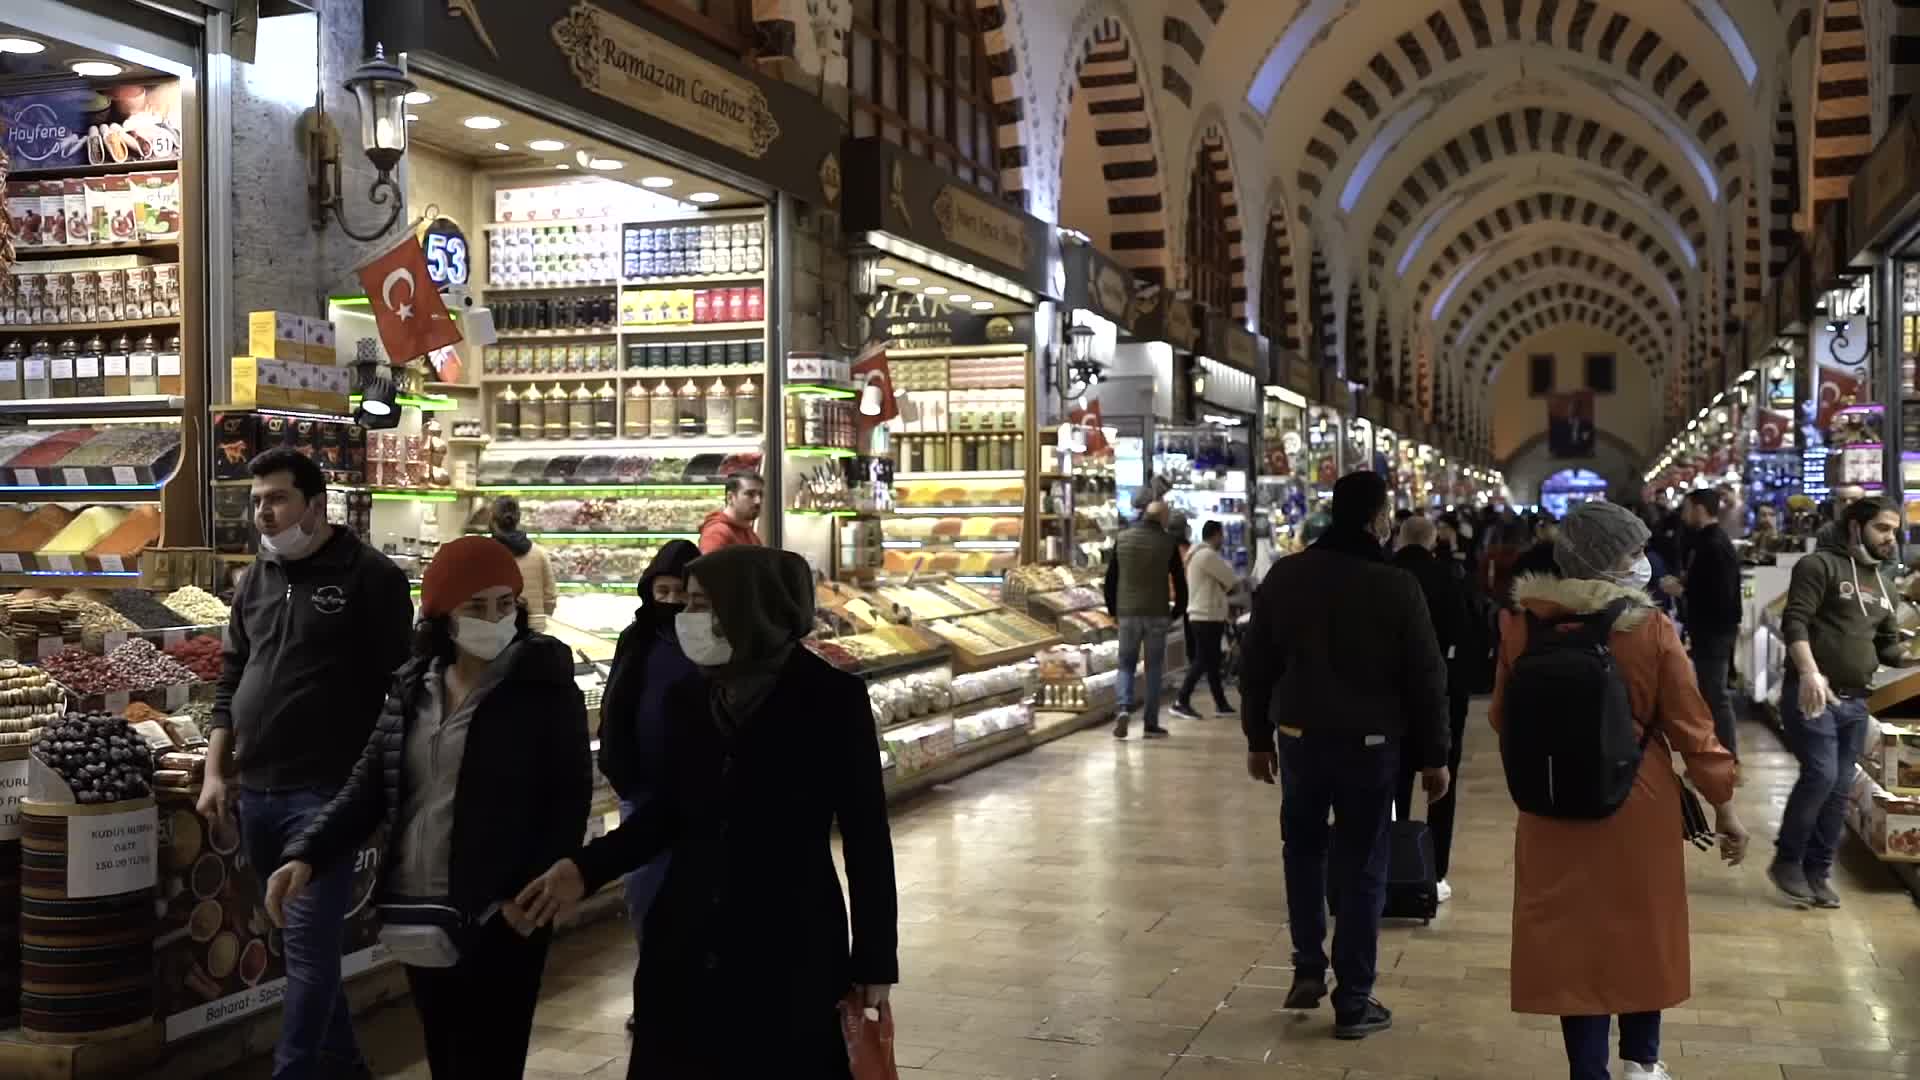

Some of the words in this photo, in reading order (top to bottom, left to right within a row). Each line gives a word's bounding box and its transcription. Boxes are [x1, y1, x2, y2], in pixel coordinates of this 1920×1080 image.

[601, 37, 687, 98] Ramazan
[9, 123, 66, 144] Hayfene
[156, 137, 169, 152] 51
[427, 233, 468, 285] 53
[206, 996, 250, 1021] Baharat
